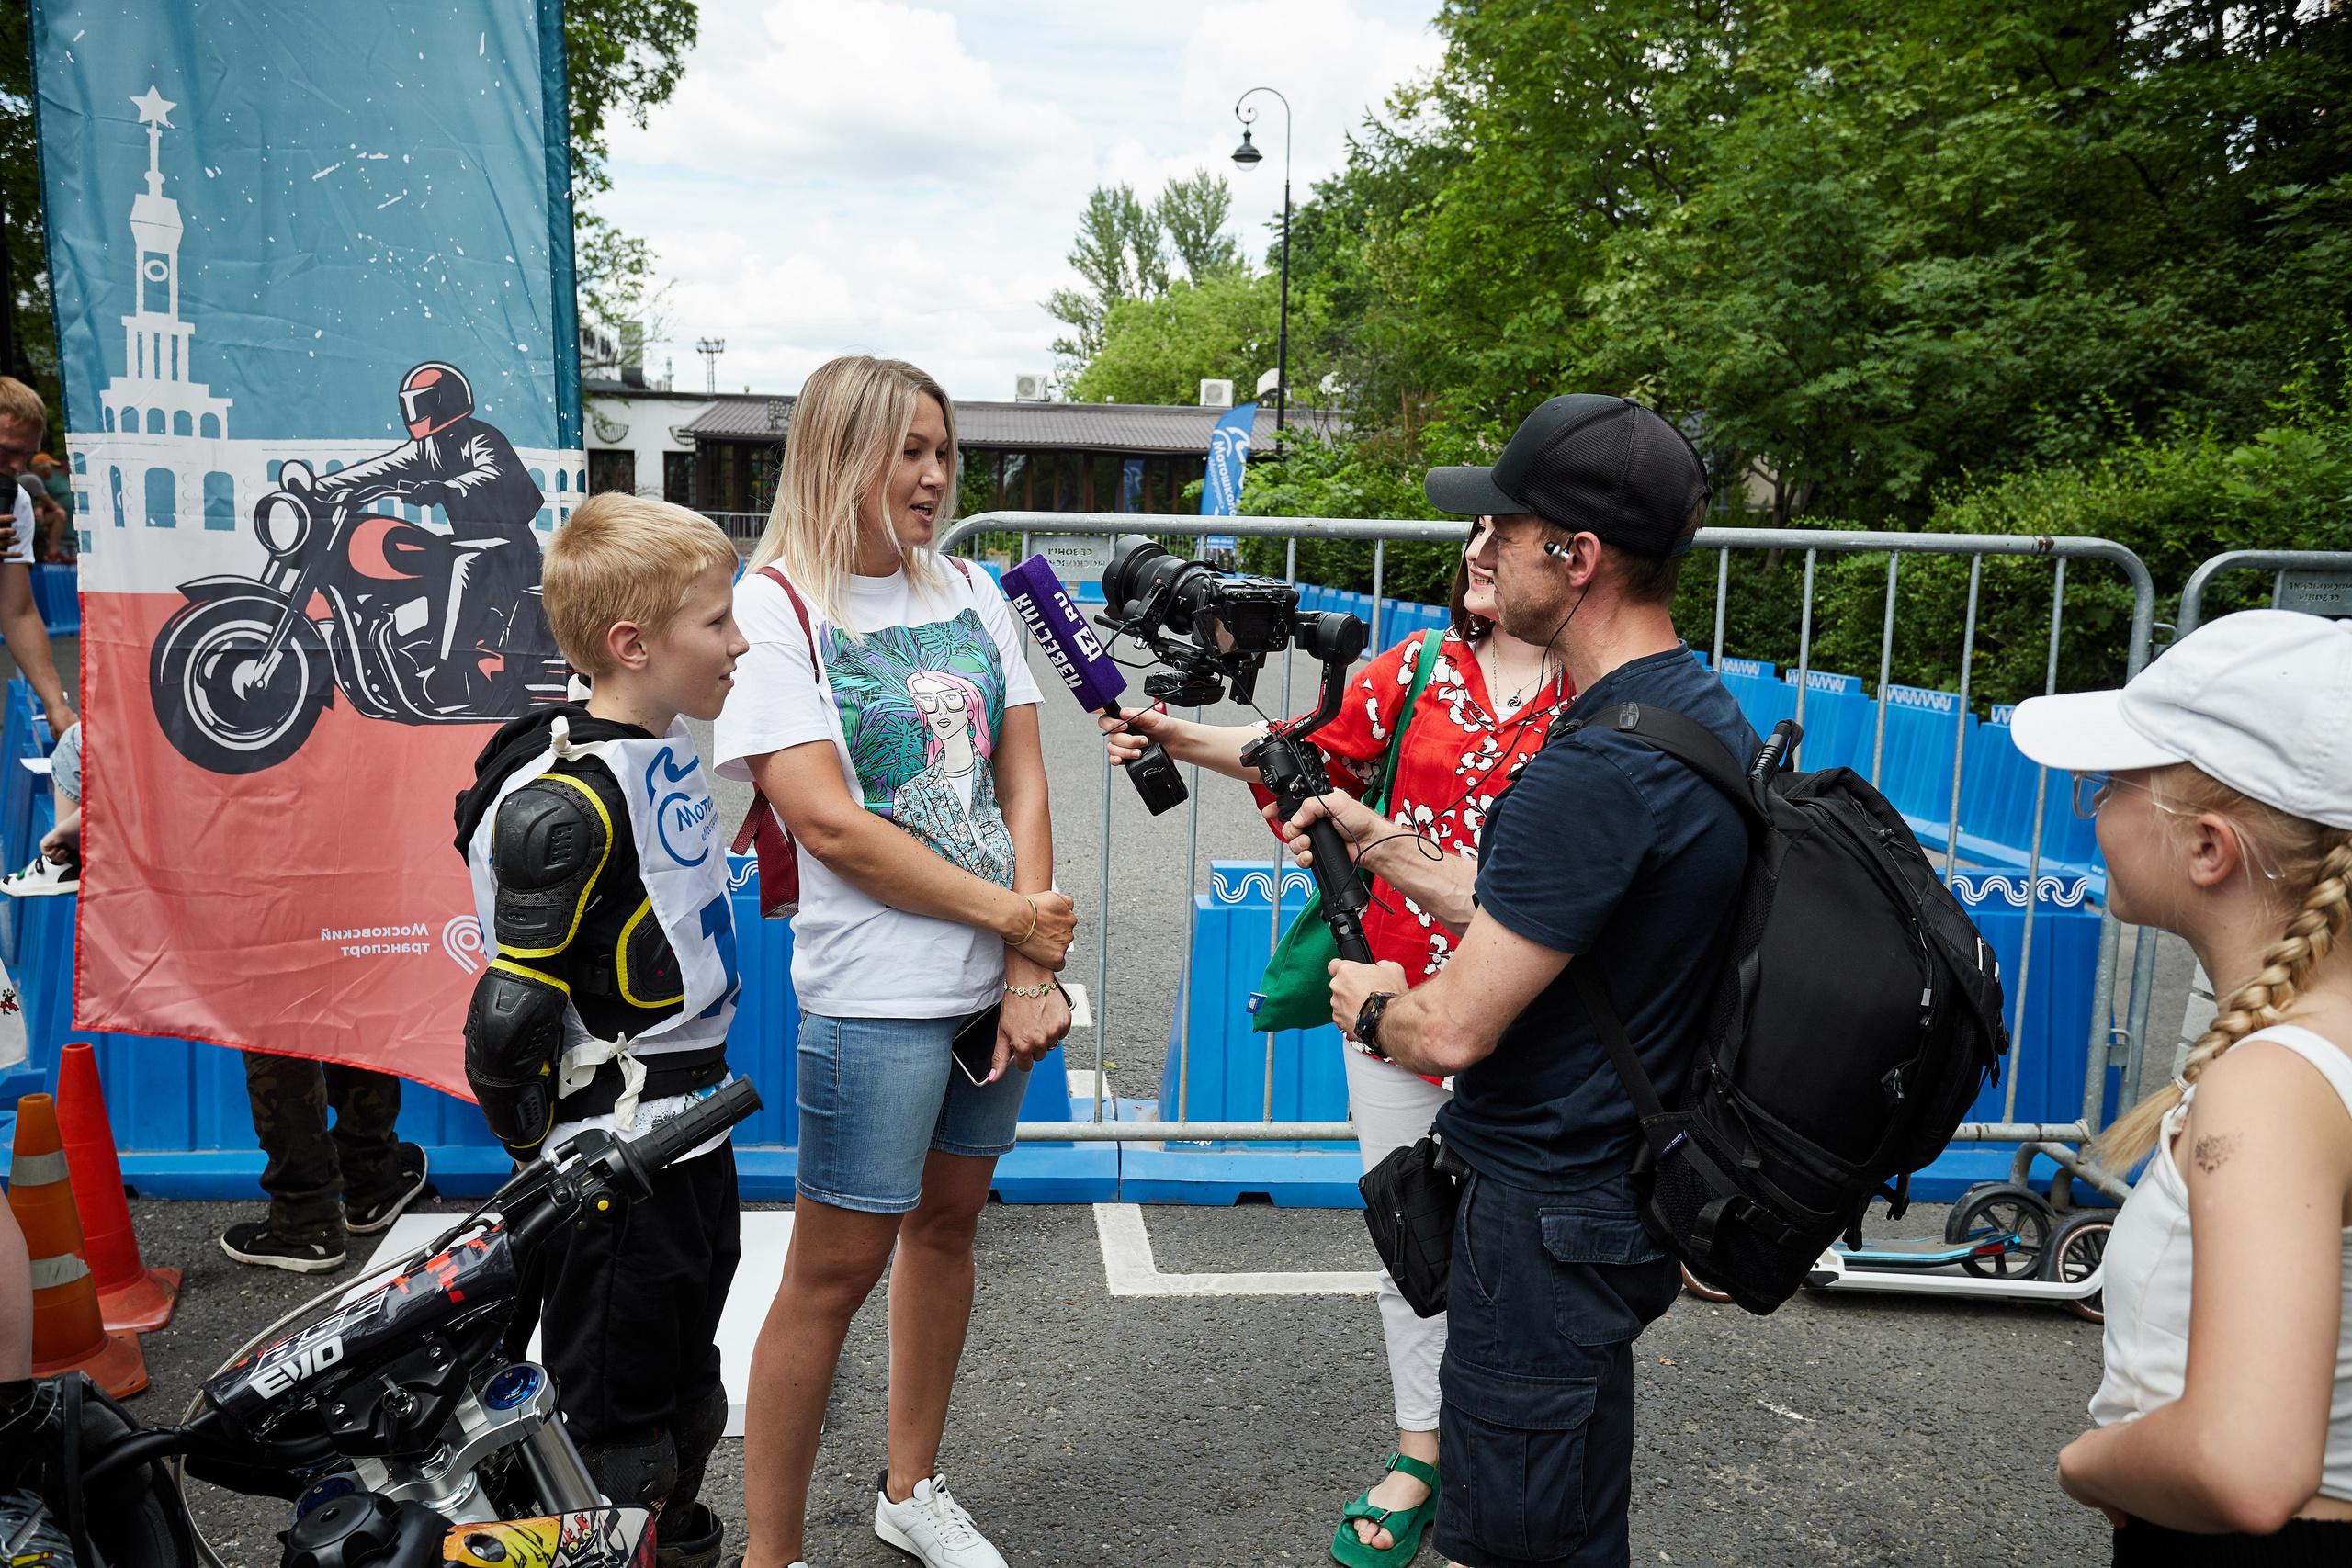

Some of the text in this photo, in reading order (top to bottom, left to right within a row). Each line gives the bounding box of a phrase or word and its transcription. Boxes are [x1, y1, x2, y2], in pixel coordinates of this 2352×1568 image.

[1046, 559, 1106, 569] МОСКОВСК
[1012, 592, 1083, 689] ИЗВЕСТИЯ
[249, 1335, 345, 1401] EVO
